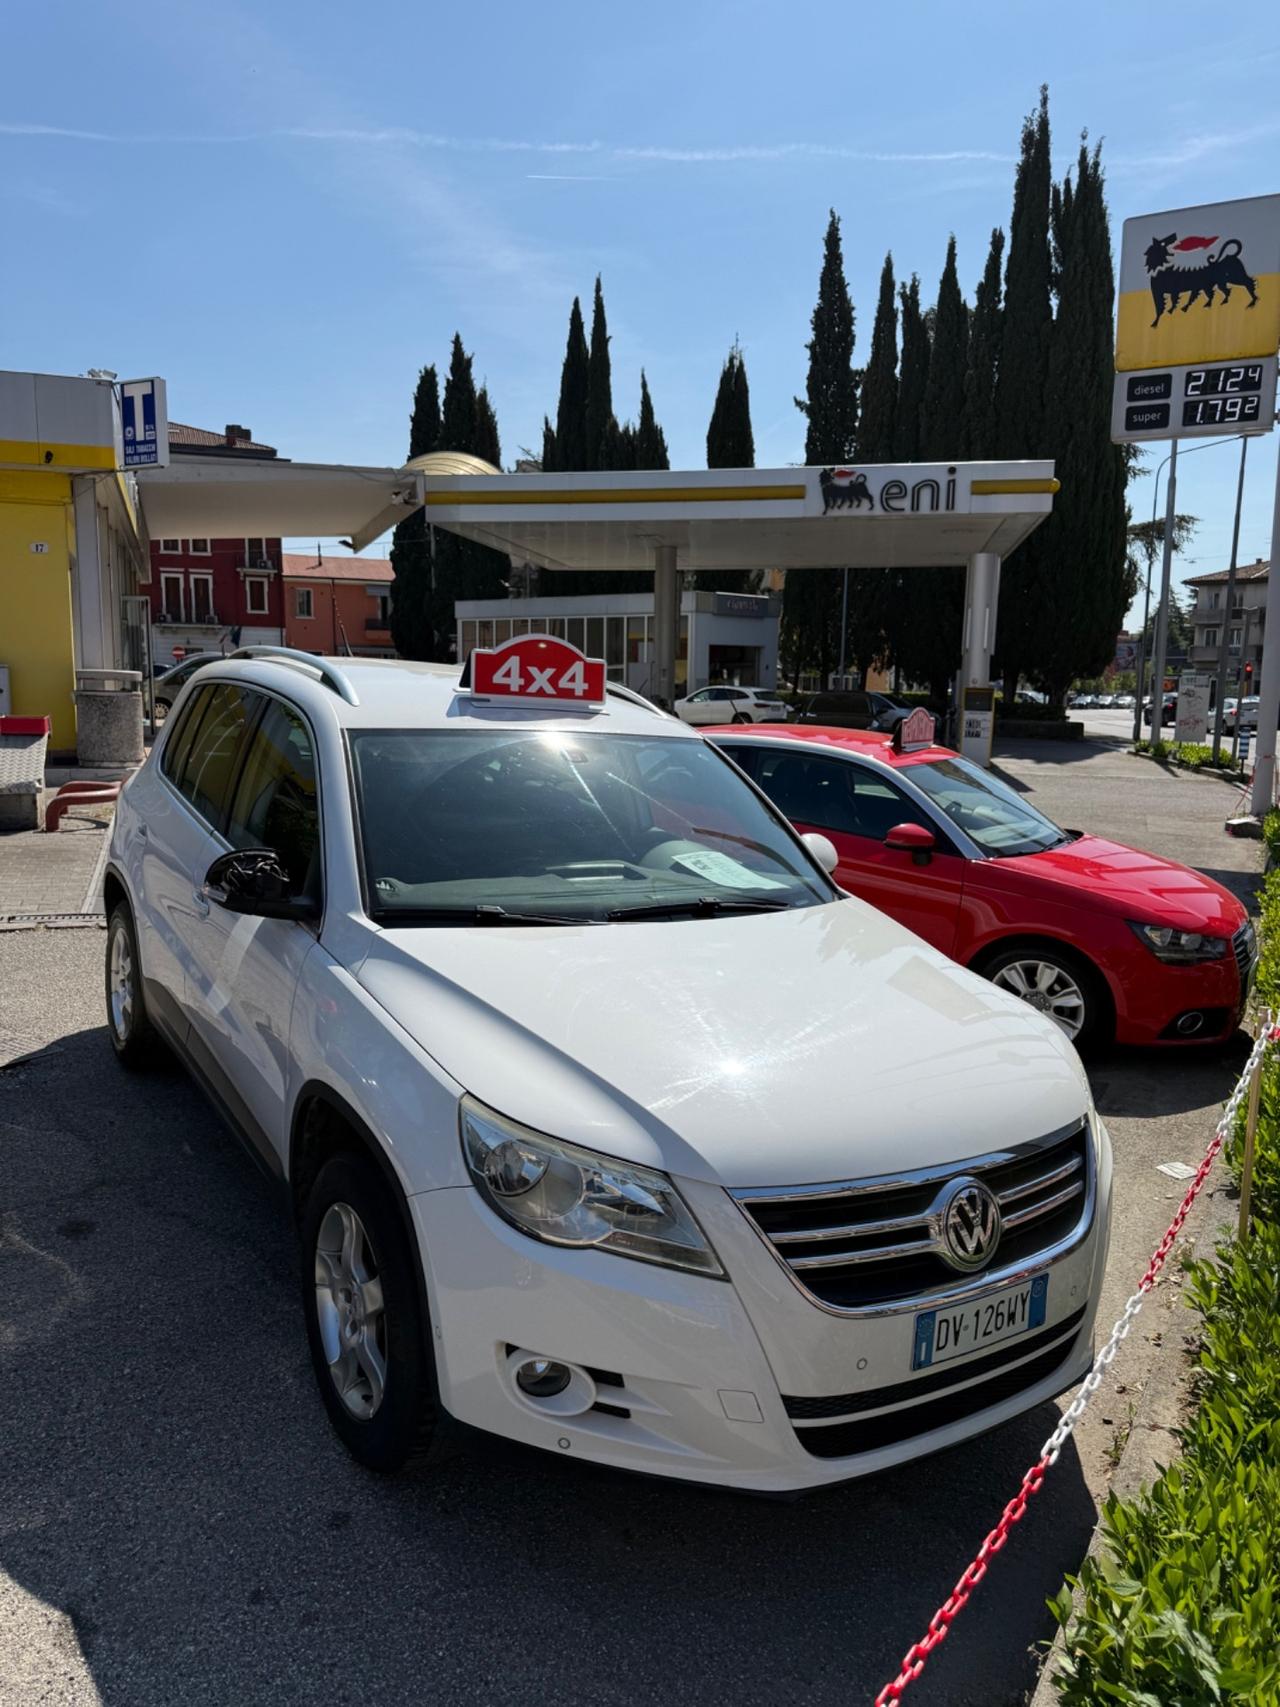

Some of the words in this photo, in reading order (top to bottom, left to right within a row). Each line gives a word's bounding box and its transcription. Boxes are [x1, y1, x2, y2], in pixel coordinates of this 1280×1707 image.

[1133, 383, 1165, 396] diesel
[123, 381, 152, 442] T
[1132, 411, 1162, 424] super
[880, 466, 957, 513] eni
[35, 543, 44, 553] 17
[491, 655, 589, 697] 4x4
